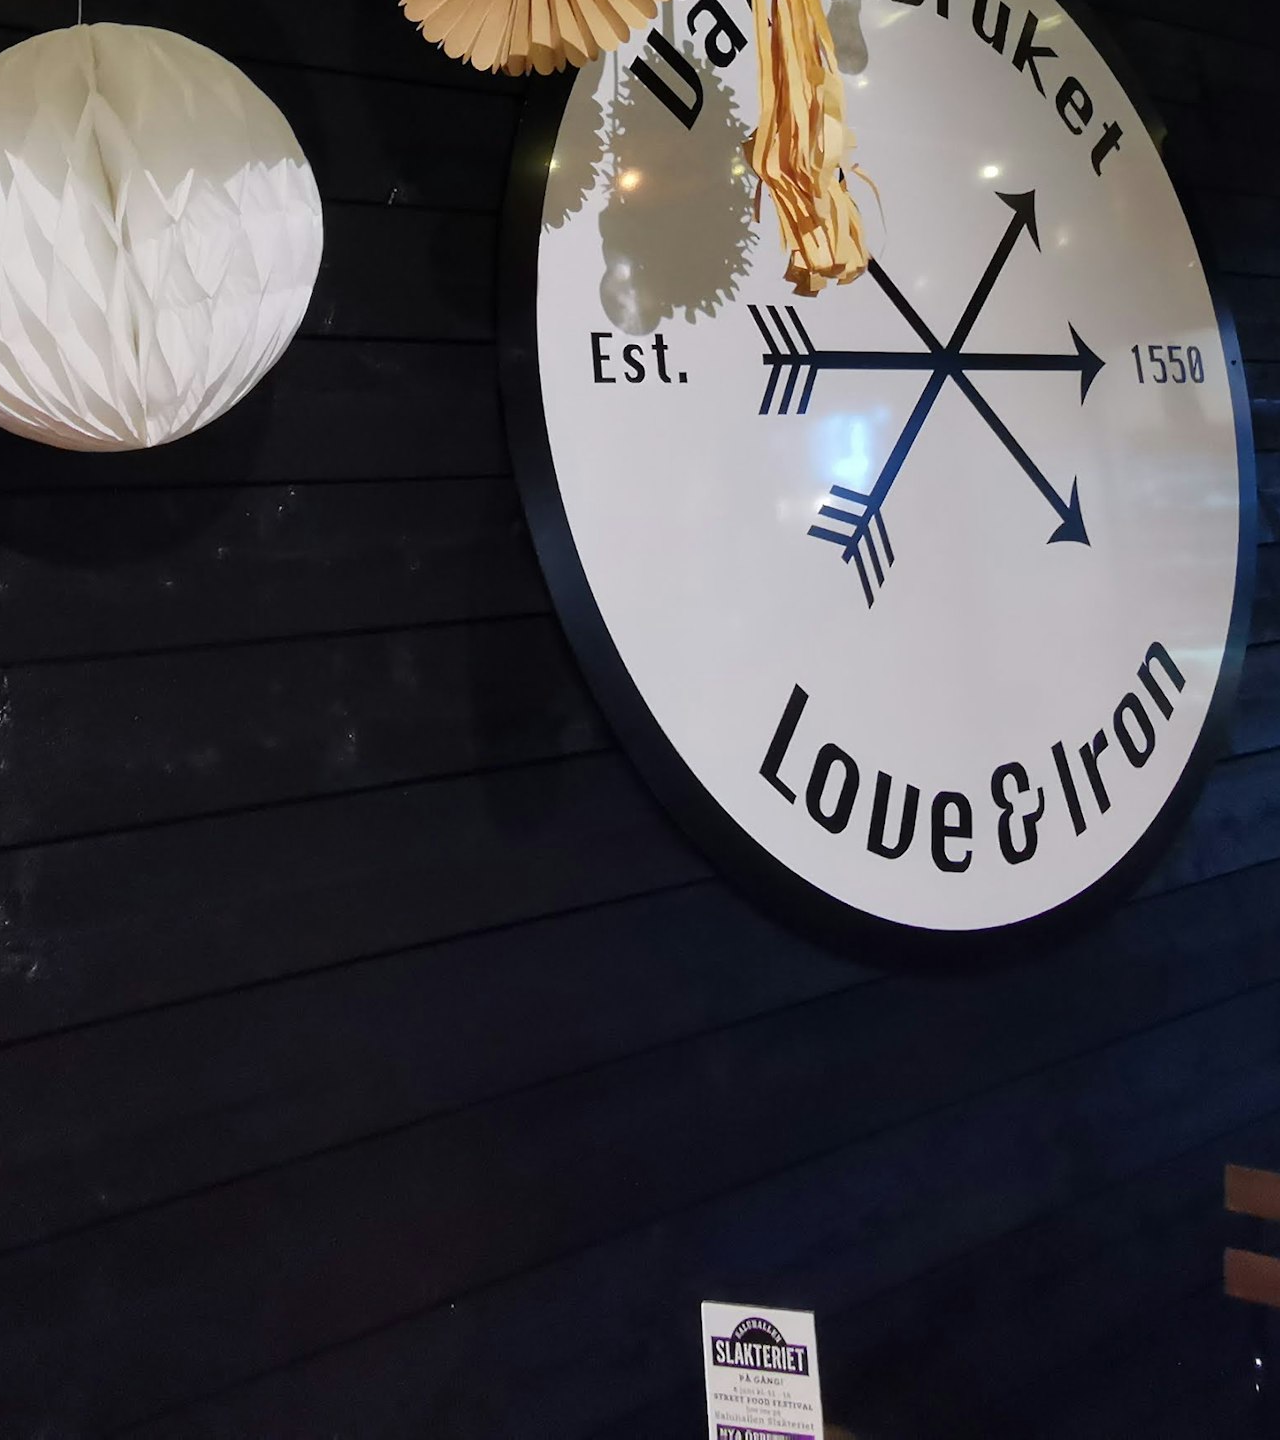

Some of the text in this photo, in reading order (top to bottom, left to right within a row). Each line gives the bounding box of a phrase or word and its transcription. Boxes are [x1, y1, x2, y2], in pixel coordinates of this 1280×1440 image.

[593, 331, 688, 384] Est.
[1131, 343, 1205, 385] 1550
[716, 1340, 805, 1371] SLAKTERIET
[714, 1393, 813, 1411] STREET FOOD FESTIVAL
